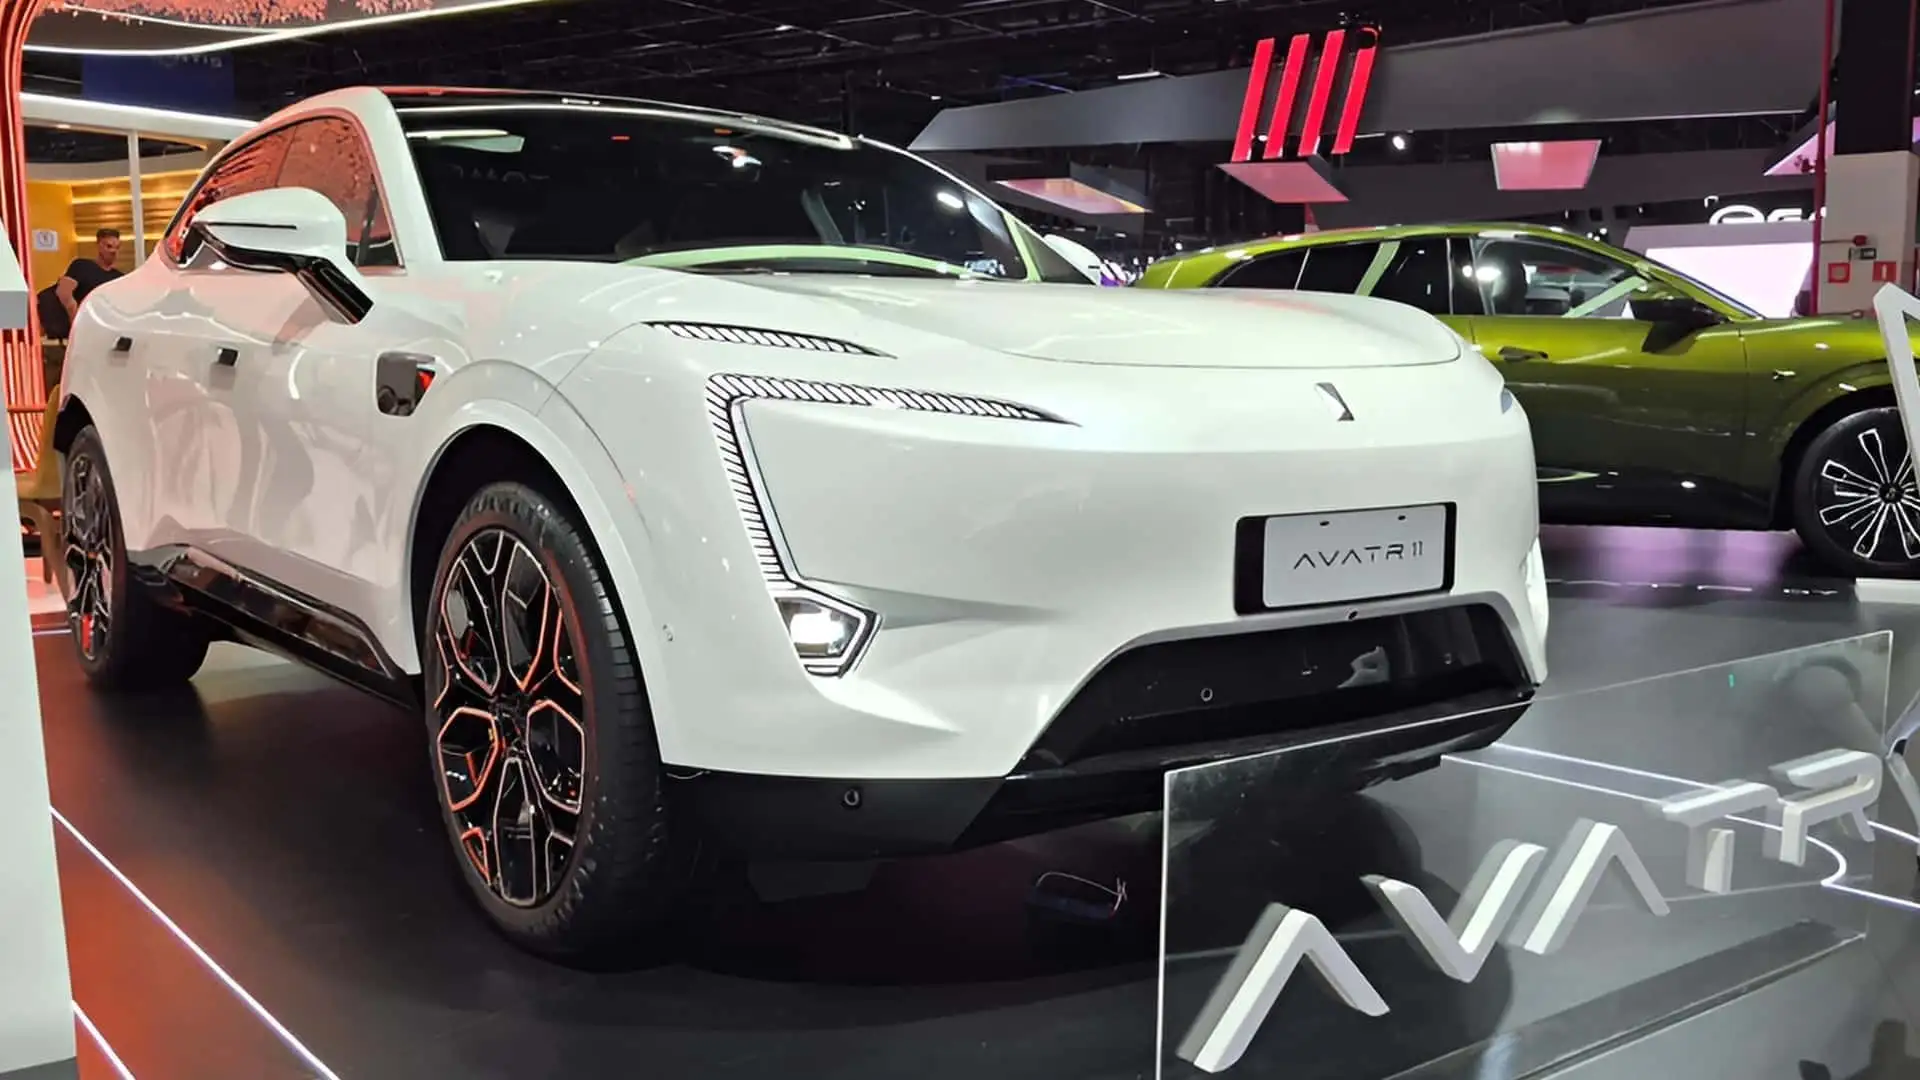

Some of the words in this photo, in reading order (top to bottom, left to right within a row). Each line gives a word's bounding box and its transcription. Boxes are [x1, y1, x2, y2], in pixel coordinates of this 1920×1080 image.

[1293, 543, 1405, 570] AVATR
[1412, 541, 1424, 557] 11
[1176, 747, 1883, 1073] AVATR
